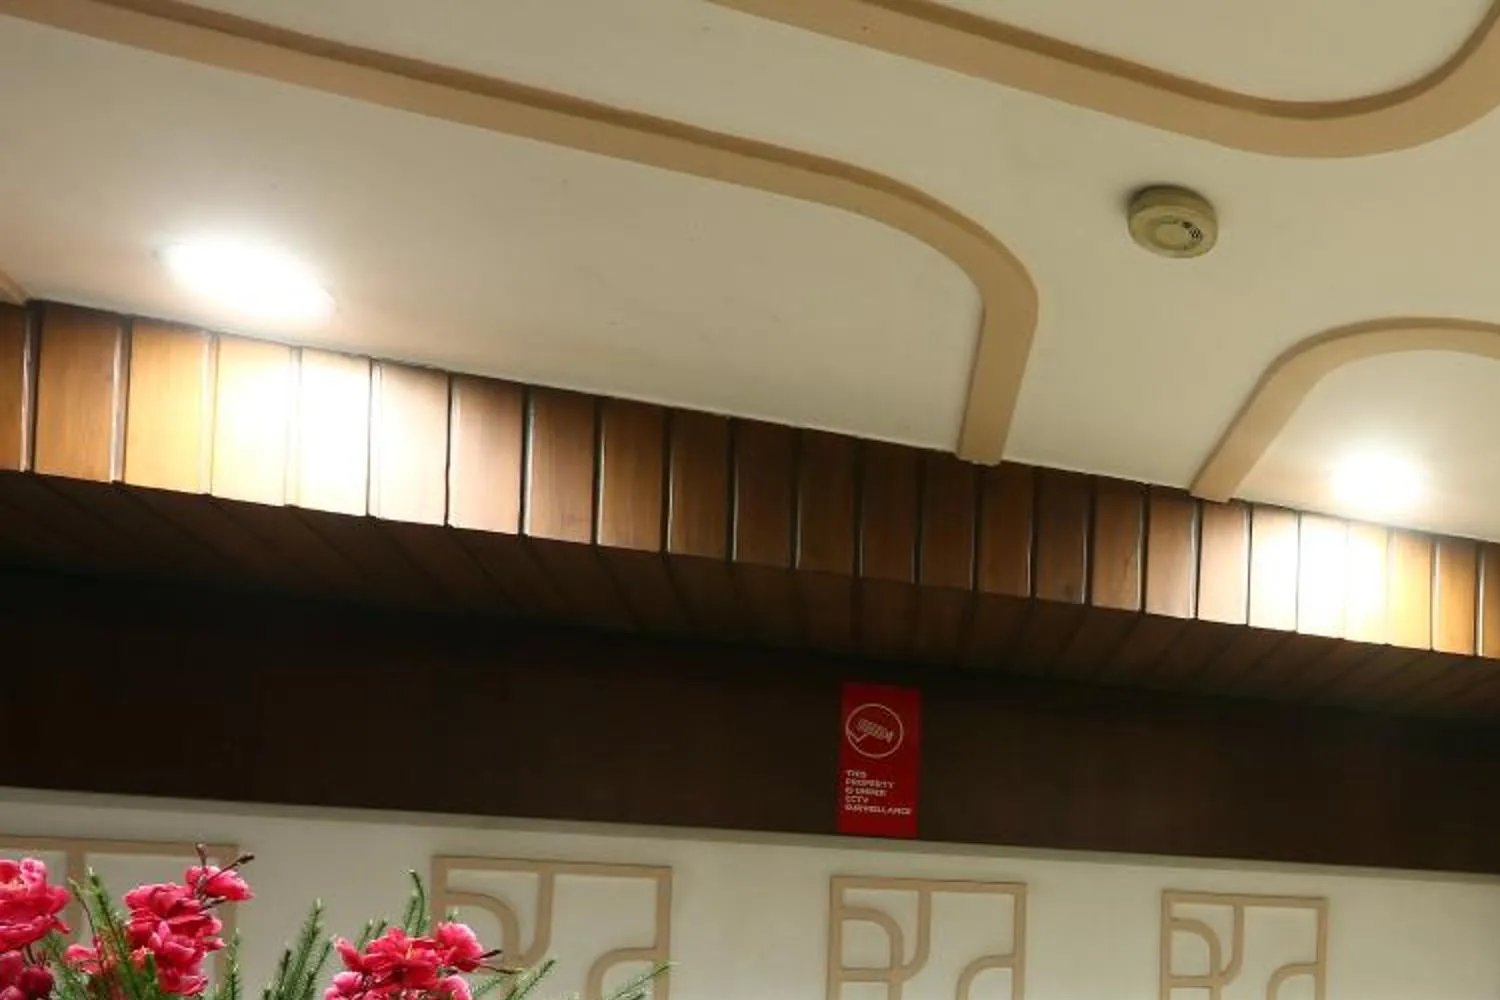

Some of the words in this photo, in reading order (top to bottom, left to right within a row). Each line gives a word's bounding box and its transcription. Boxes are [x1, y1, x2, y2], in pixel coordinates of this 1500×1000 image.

[846, 769, 867, 778] THIS
[845, 778, 895, 788] PROPERTY
[856, 787, 887, 796] UNDER
[845, 795, 869, 803] CCTV
[844, 804, 912, 815] SURVEILLANCE
